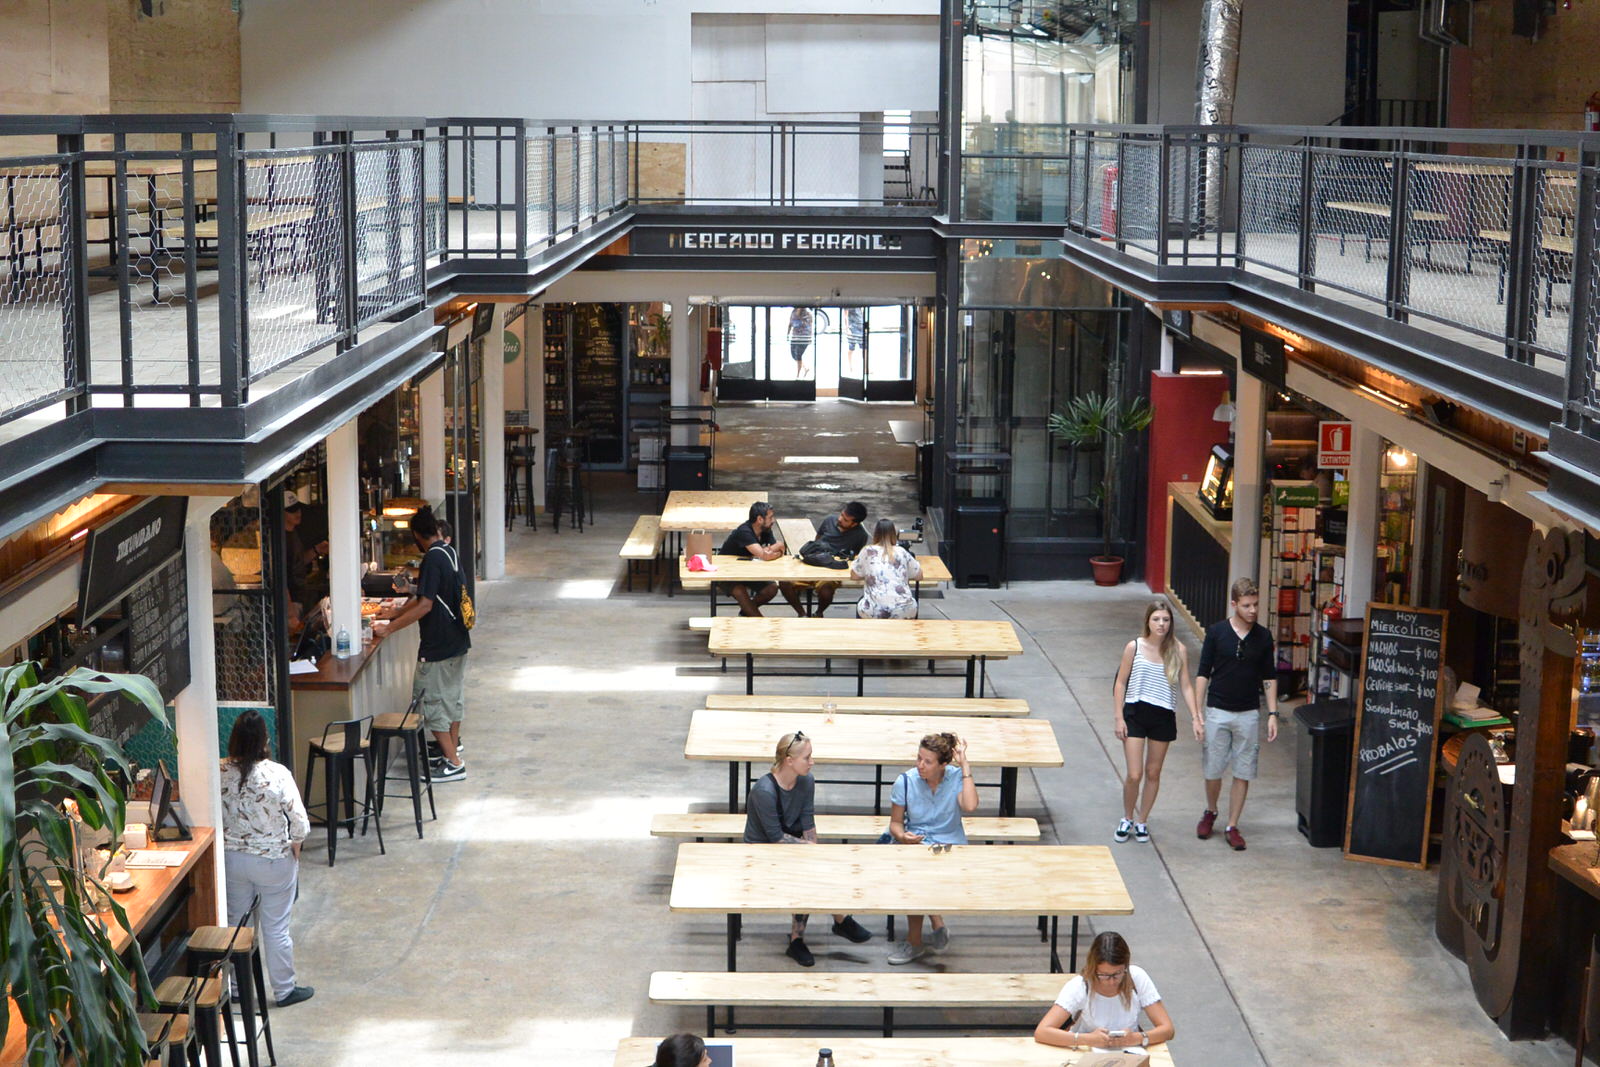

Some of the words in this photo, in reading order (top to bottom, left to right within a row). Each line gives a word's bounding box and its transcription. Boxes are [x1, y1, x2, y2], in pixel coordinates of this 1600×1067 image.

[669, 232, 774, 249] MERCADO
[1321, 455, 1350, 464] EXTINTOR
[1369, 641, 1398, 656] NACHOS
